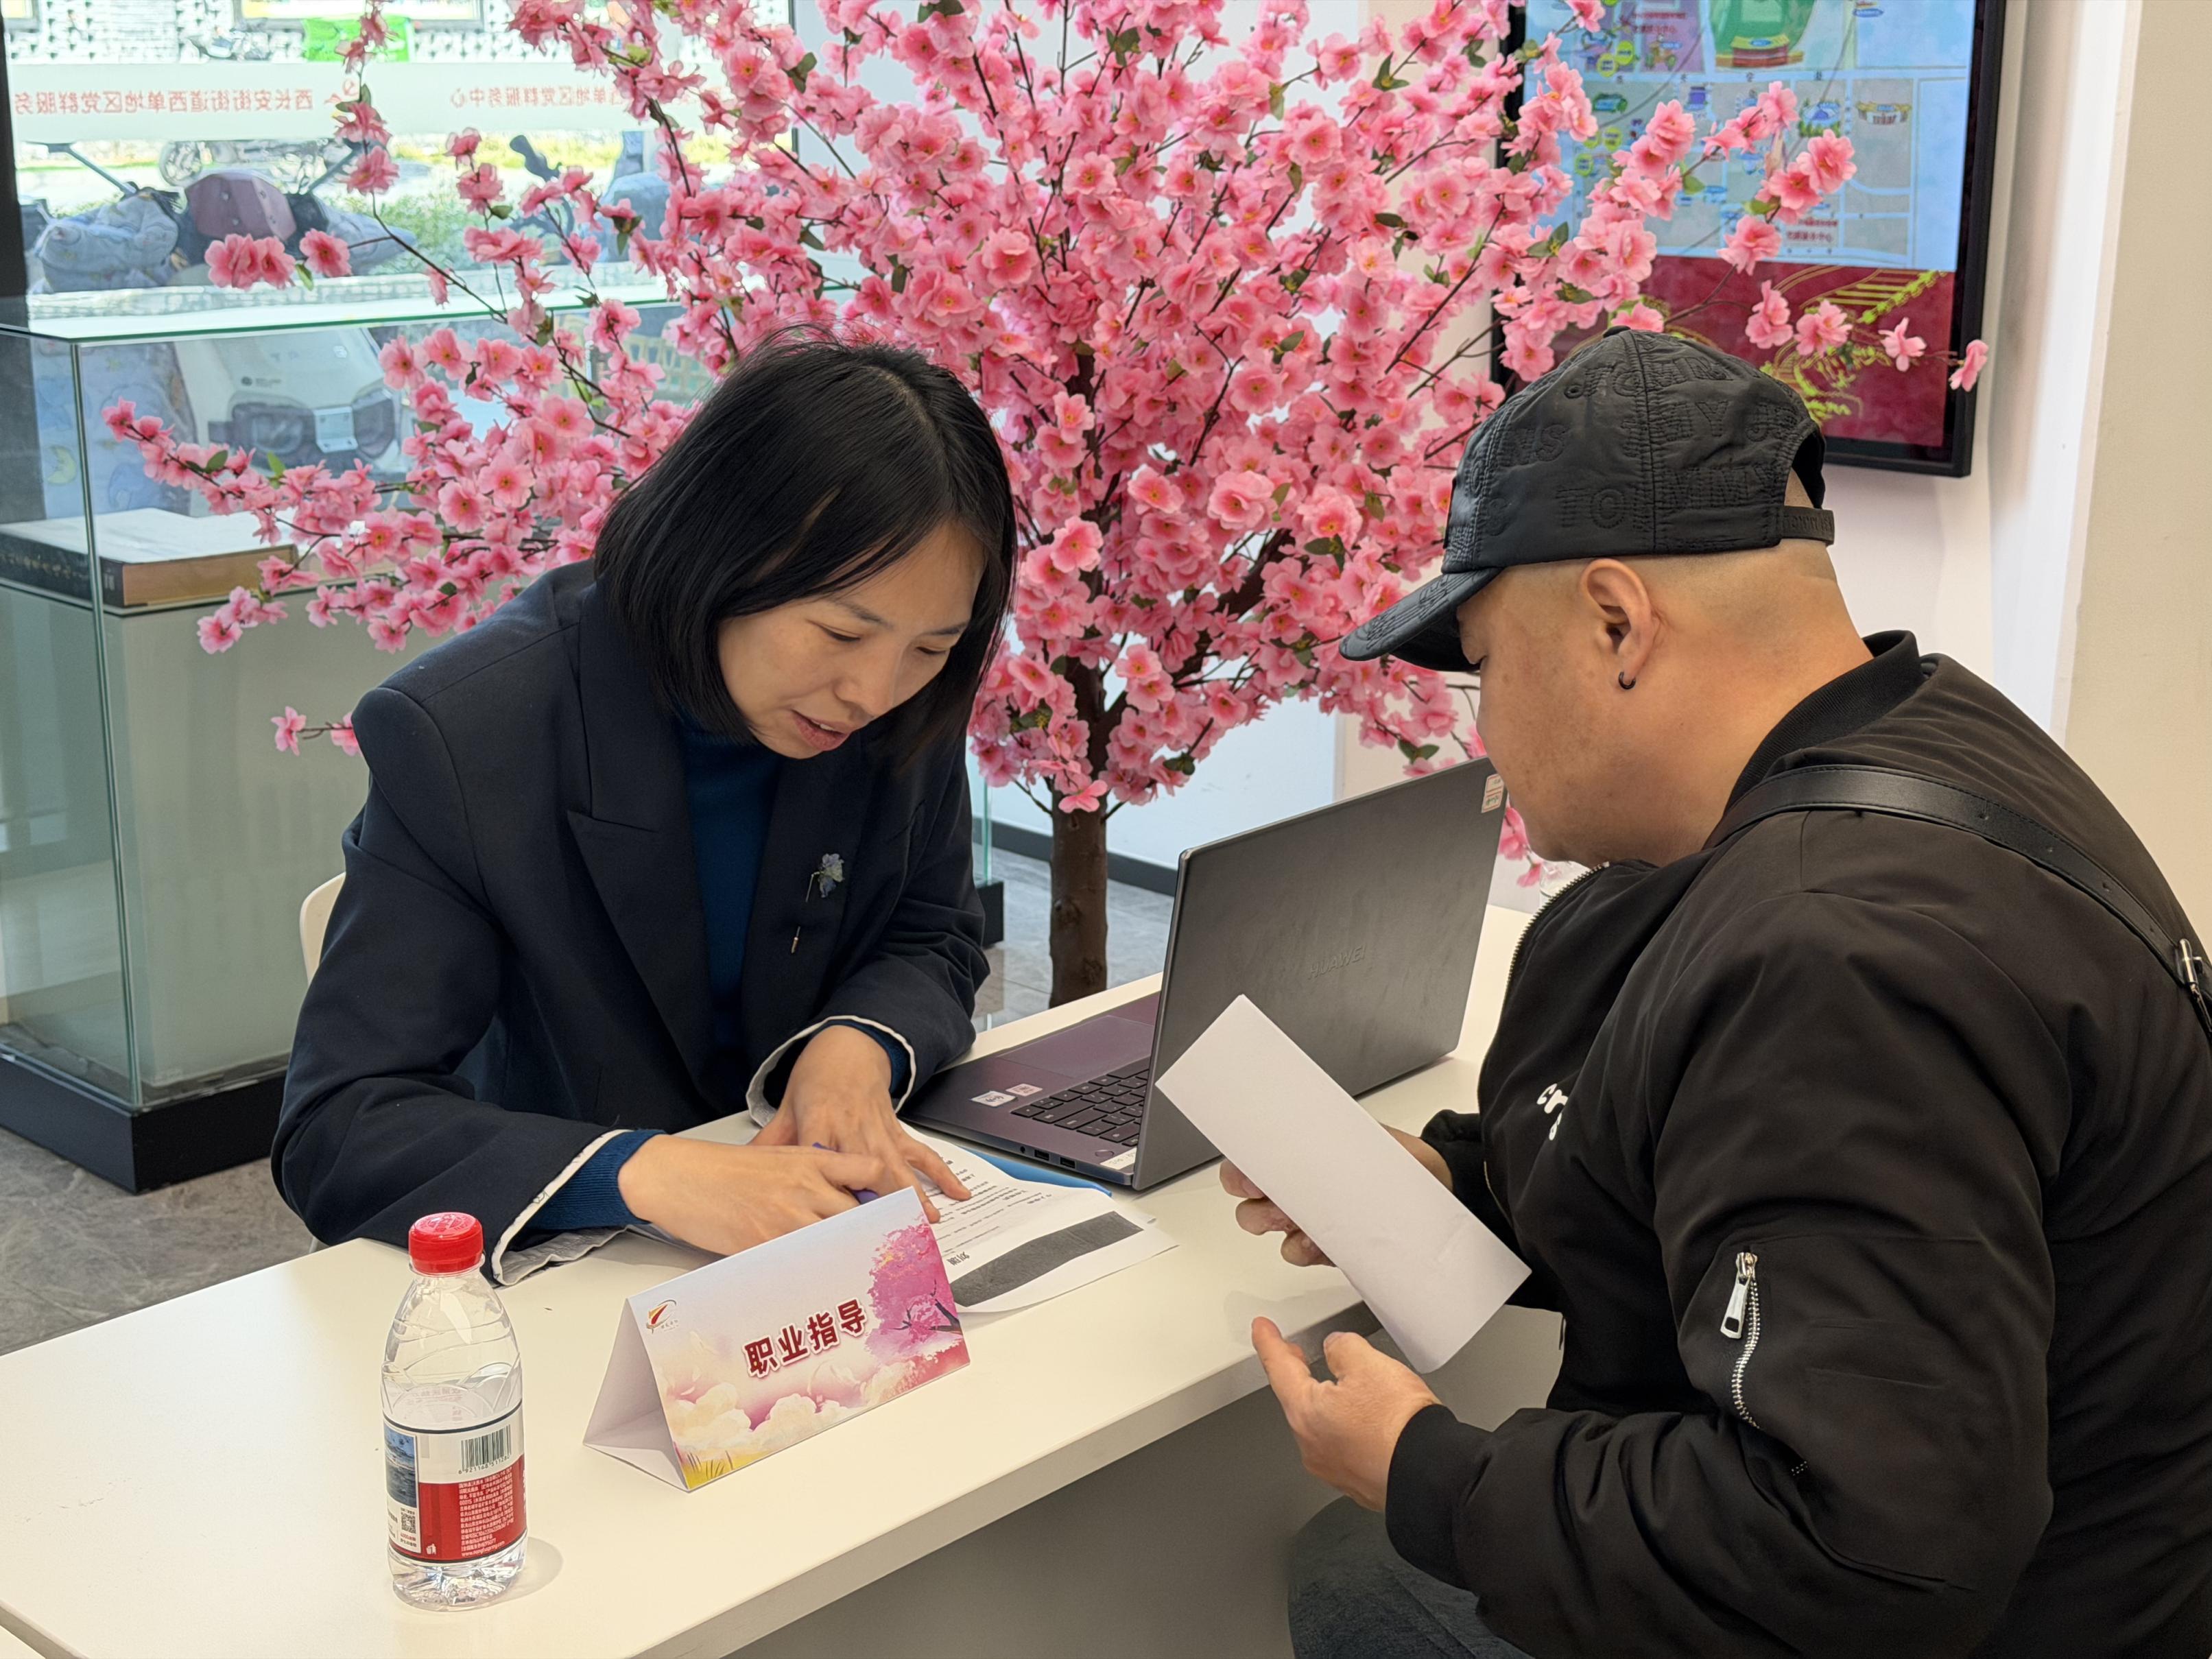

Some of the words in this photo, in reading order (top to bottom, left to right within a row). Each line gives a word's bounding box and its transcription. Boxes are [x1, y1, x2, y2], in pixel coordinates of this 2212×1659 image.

[1307, 943, 1367, 981] HUAWEI
[744, 1298, 868, 1375] 职业指导
